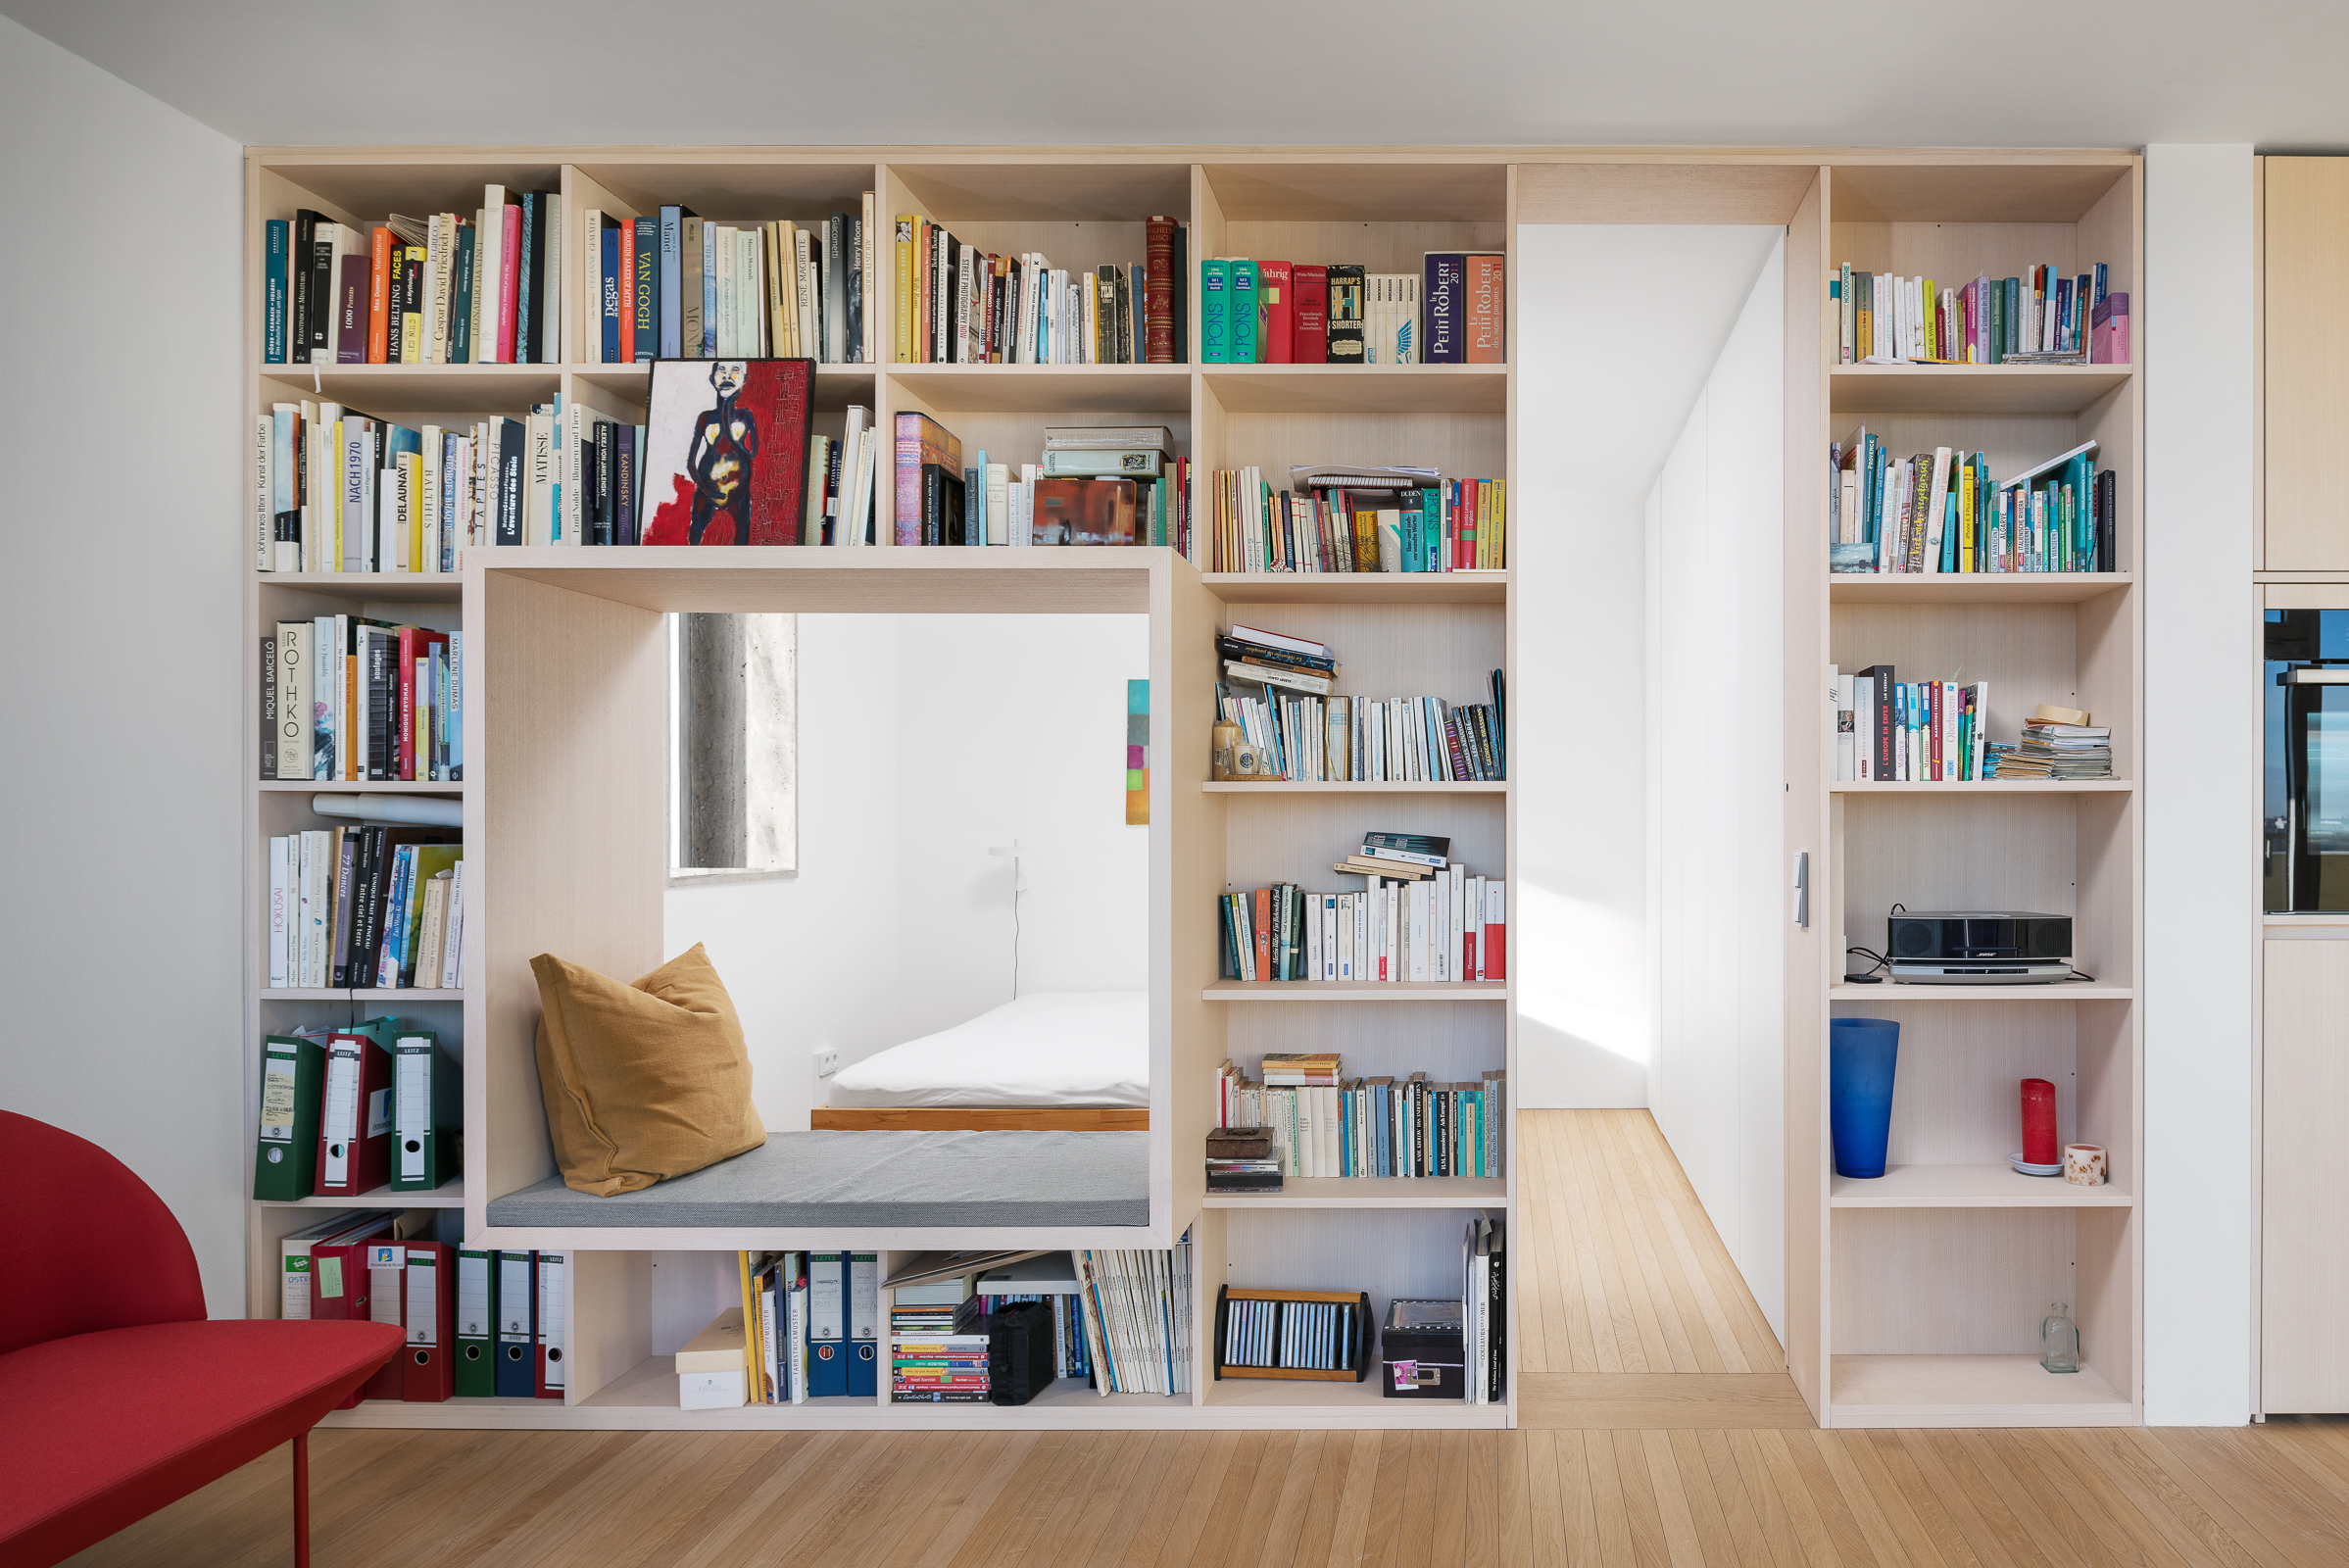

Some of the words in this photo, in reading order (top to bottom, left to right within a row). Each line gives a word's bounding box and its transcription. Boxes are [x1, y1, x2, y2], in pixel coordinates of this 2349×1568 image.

[437, 233, 449, 274] Friedrich
[663, 221, 673, 253] Manet
[831, 217, 840, 259] Giacometti
[393, 251, 402, 279] FACES
[474, 273, 481, 282] DA
[639, 252, 651, 281] VAN
[798, 239, 807, 281] MAGRITTE
[854, 248, 862, 270] Henry
[391, 284, 401, 325] BELTING
[436, 277, 447, 306] David
[472, 284, 481, 336] LEONARDO
[605, 277, 618, 317] Degas
[638, 284, 650, 329] GOGH
[960, 282, 969, 324] PHOTOGRAPHY
[390, 328, 399, 356] HANS
[434, 308, 446, 340] Caspar
[1207, 303, 1223, 346] PONS
[1235, 303, 1250, 345] PONS
[1332, 320, 1361, 329] SHORTER
[350, 442, 361, 468] 1970
[489, 444, 500, 501] PICASSO
[536, 432, 548, 484] MATISSE
[350, 472, 361, 503] NACH
[398, 466, 408, 521] DELAUNAY
[424, 470, 433, 528] BALTHUS
[475, 463, 486, 528] TAPIES
[508, 490, 517, 535] L'aventure
[1428, 499, 1439, 530] PONS
[265, 642, 274, 682] BARCELÓ
[267, 686, 276, 719] MIQUEL
[284, 632, 299, 737] ROTHKO
[1946, 696, 1956, 743] Oberbayern
[342, 855, 350, 865] 77
[340, 867, 349, 898] Dances
[273, 888, 283, 932] HOKUSAI
